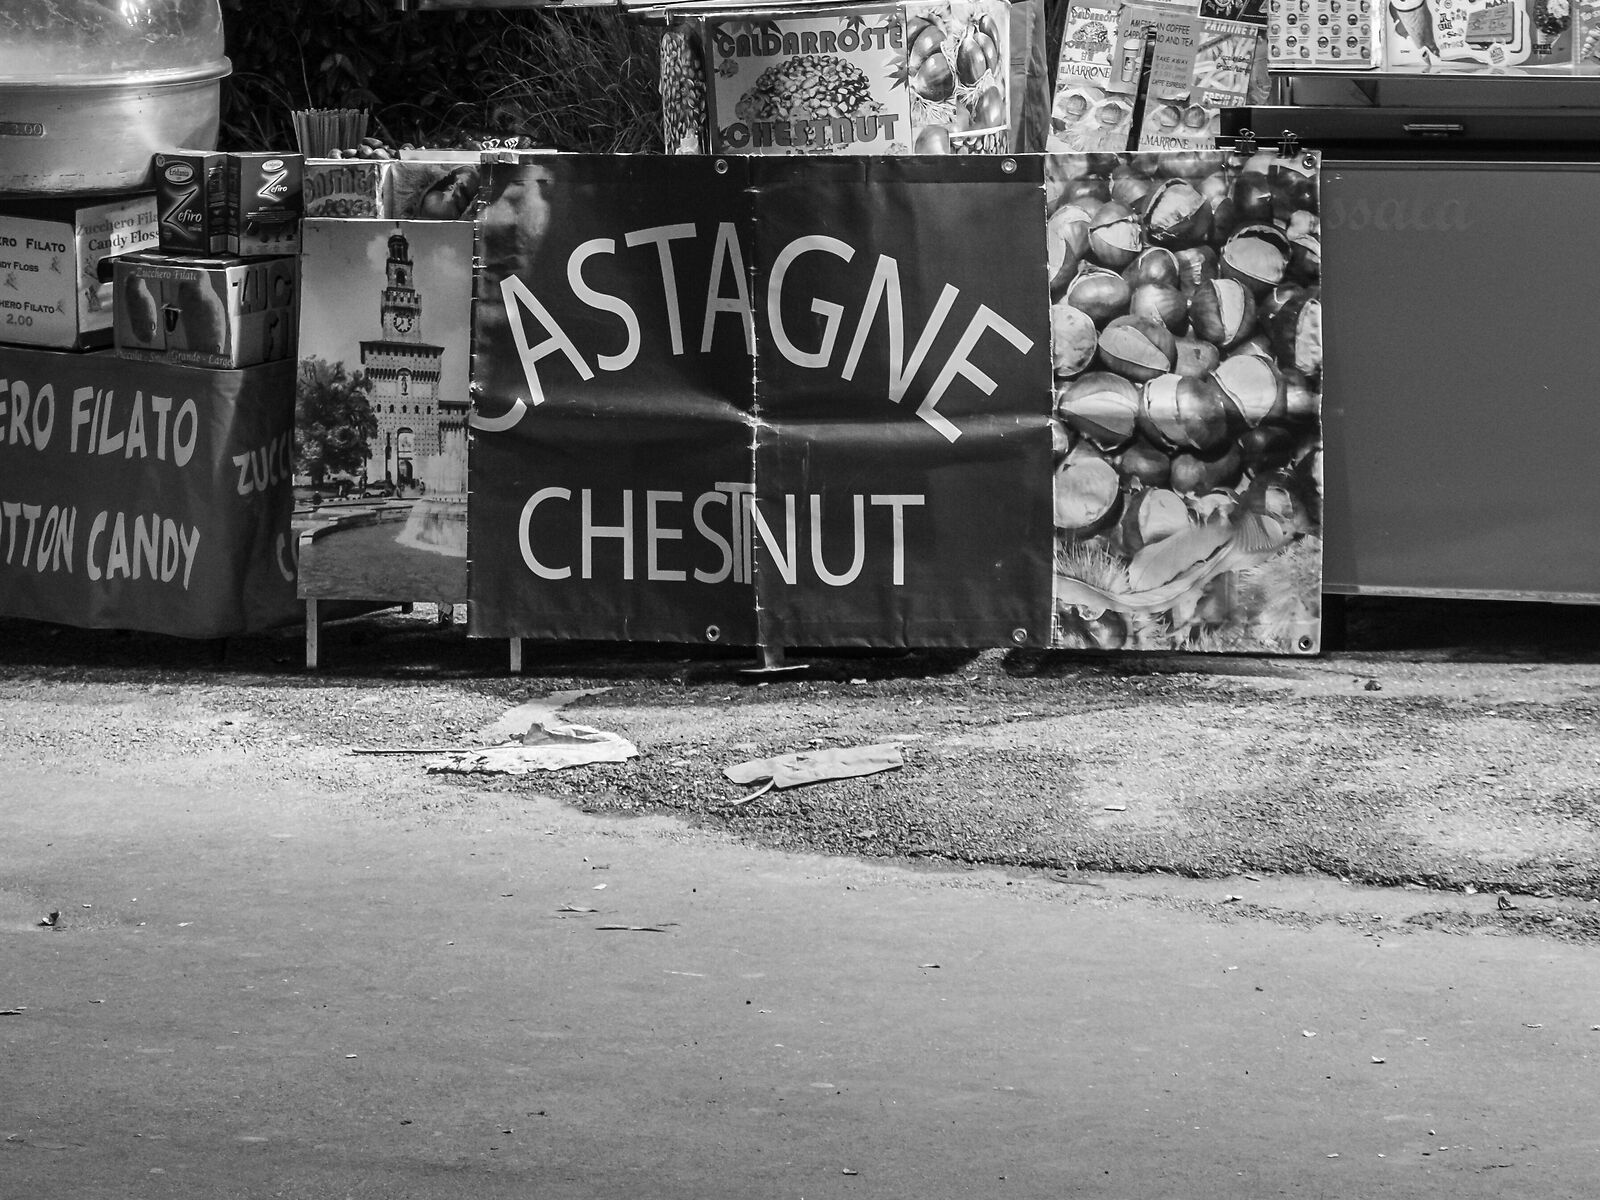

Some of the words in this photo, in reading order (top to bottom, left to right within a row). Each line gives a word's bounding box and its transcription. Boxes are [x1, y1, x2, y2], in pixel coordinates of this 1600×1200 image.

[1166, 23, 1191, 35] COFFEE
[1204, 21, 1248, 35] PATATINE
[716, 25, 903, 58] CALDARROSTE
[1165, 35, 1180, 46] AND
[1182, 37, 1194, 47] TEA
[1067, 64, 1111, 80] MARRONE
[722, 113, 899, 149] CHESTNUT
[1146, 135, 1190, 150] MARRONE
[257, 169, 288, 202] Zefiro
[161, 186, 202, 238] Zefiro
[78, 218, 135, 235] Zucchero
[26, 238, 66, 253] FILATO
[88, 234, 128, 251] Candy
[130, 230, 160, 244] Floss
[13, 261, 39, 272] FLOSS
[136, 267, 171, 280] Zucchero
[24, 301, 55, 314] FILATO
[6, 313, 33, 327] 2.00
[70, 385, 198, 467] FILATO
[518, 482, 926, 586] CHESTNUT
[0, 502, 77, 573] TTON
[87, 510, 200, 591] CANDY
